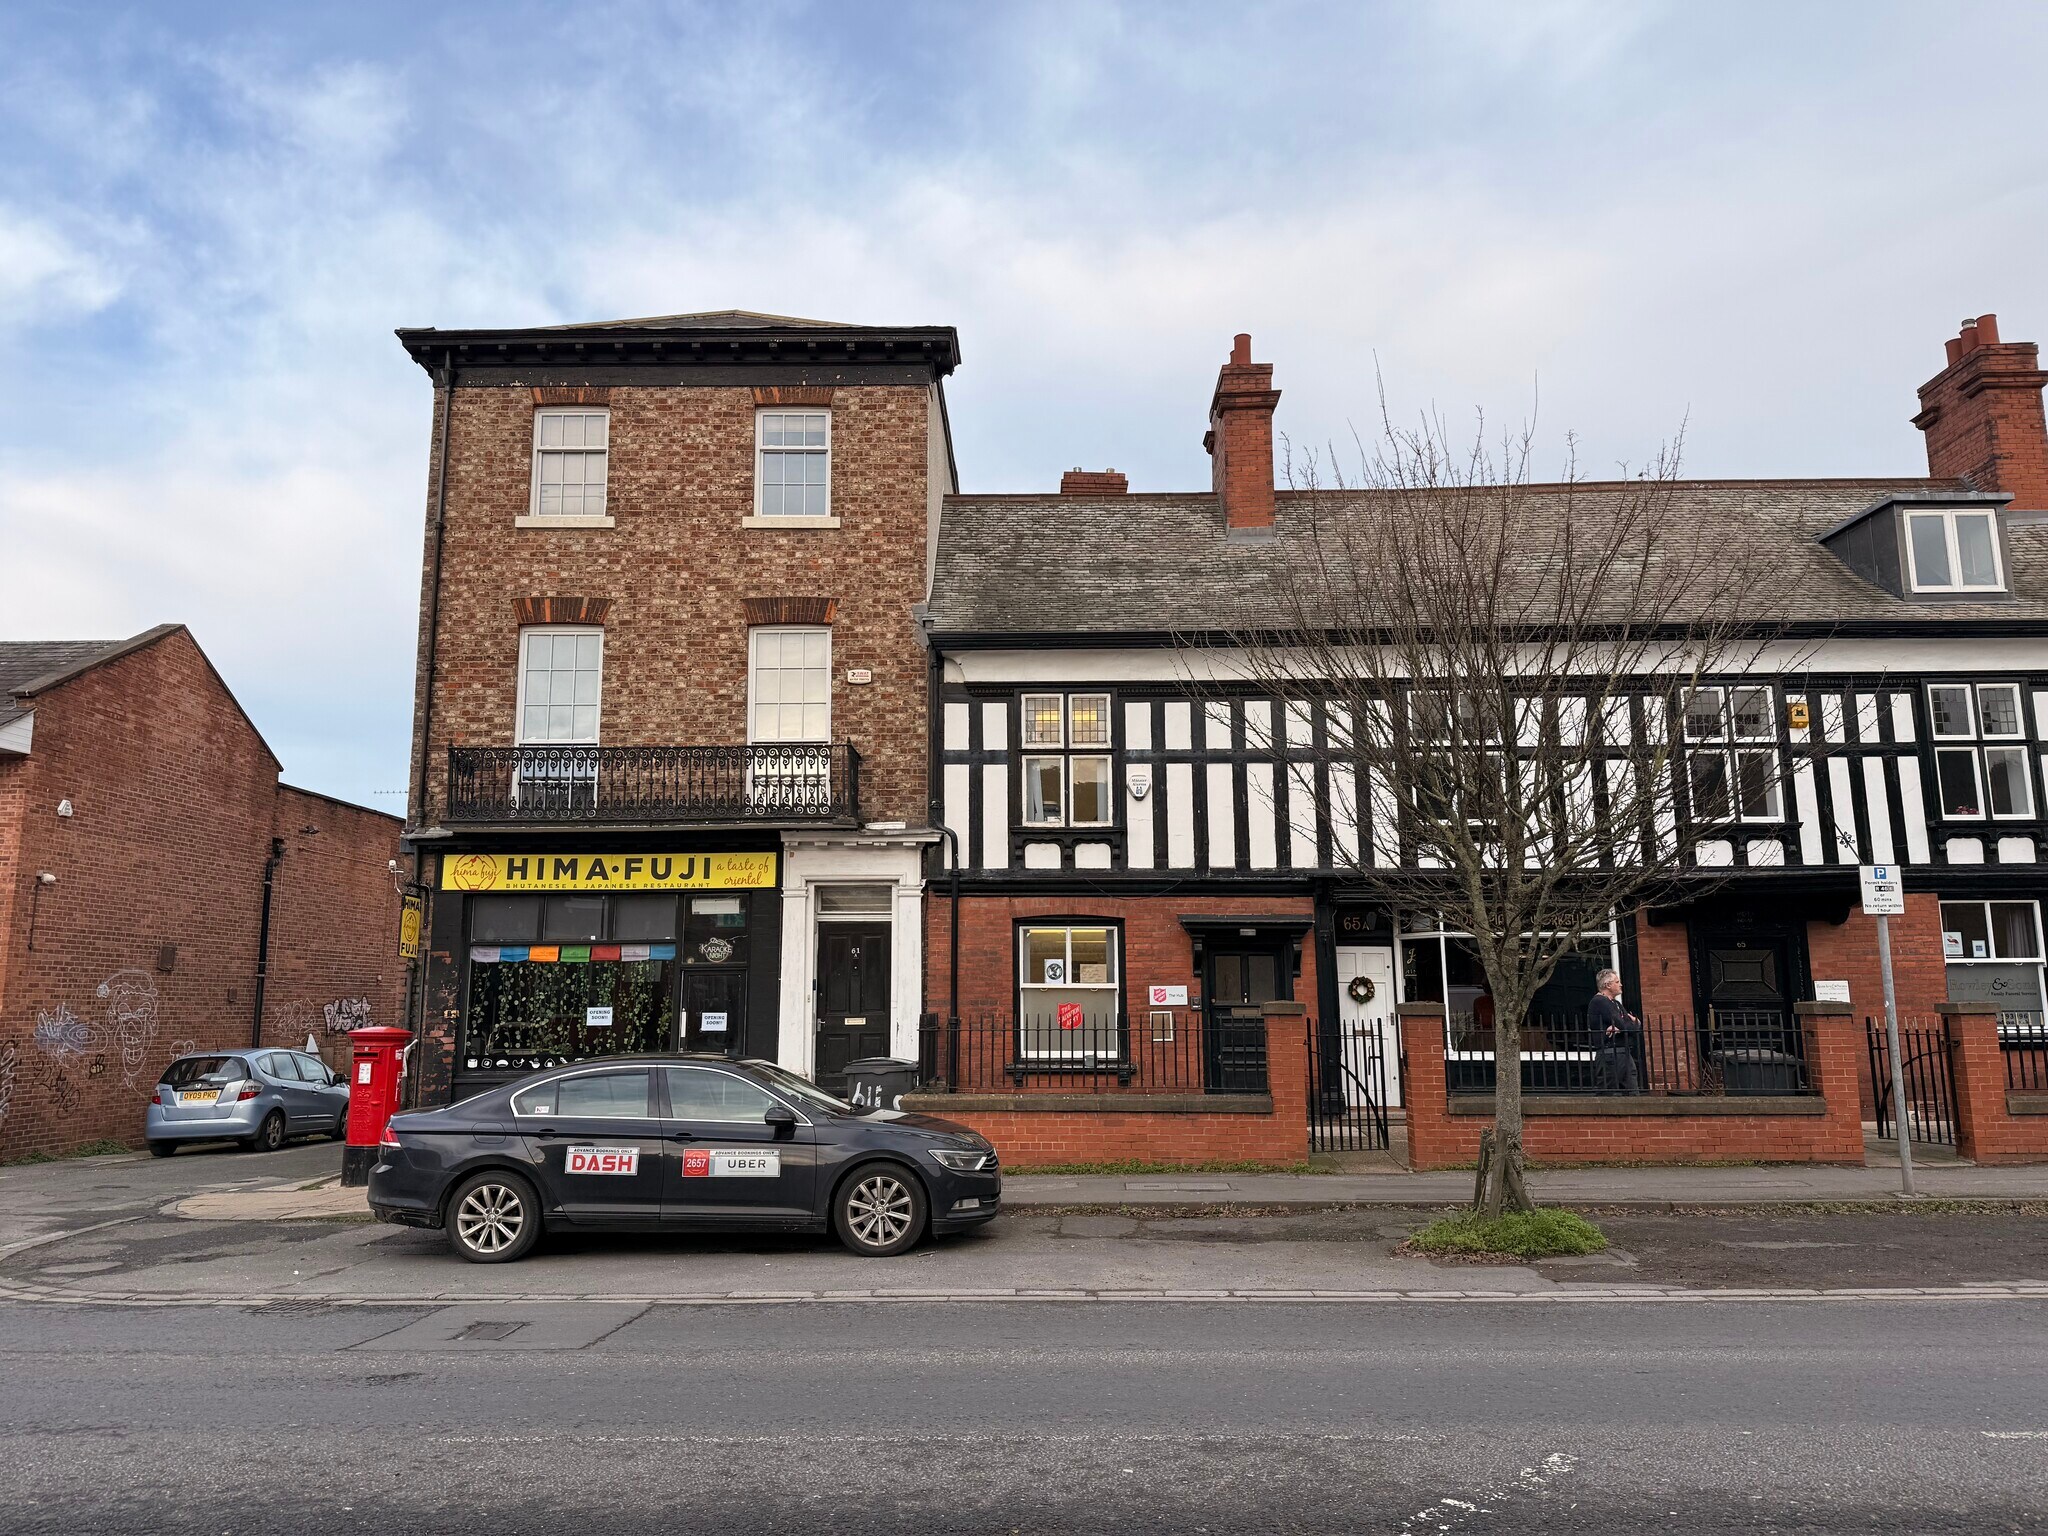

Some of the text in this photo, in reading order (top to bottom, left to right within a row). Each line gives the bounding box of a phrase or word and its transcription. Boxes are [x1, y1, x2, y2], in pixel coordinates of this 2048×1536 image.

[450, 864, 502, 880] hima fuji
[727, 857, 756, 871] taste
[758, 856, 769, 873] of
[723, 871, 763, 886] oriental
[400, 942, 417, 955] FUJI
[572, 1154, 632, 1172] DASH
[686, 1158, 707, 1168] 2657
[727, 1159, 767, 1168] UBER
